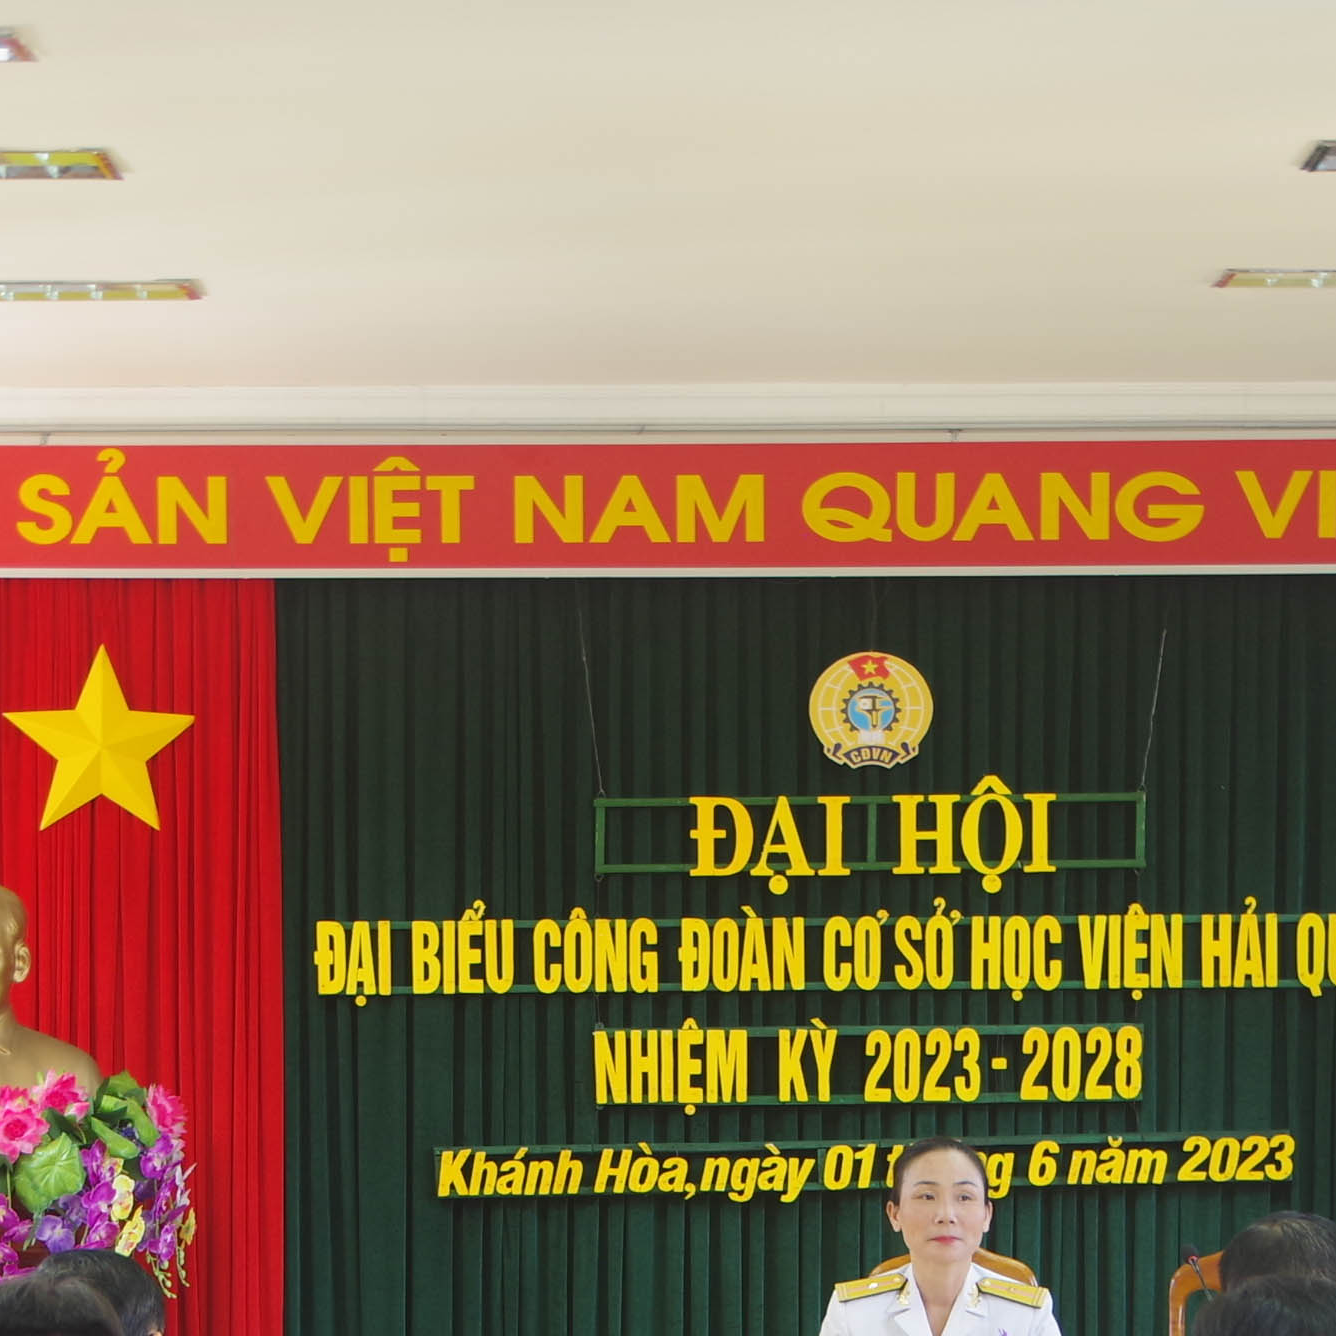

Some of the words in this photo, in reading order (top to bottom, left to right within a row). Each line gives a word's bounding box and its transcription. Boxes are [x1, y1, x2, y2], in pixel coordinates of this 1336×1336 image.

[16, 447, 228, 546] SẢN
[265, 456, 475, 562] VIỆT
[513, 474, 765, 544] NAM
[801, 471, 1206, 543] QUANG
[689, 795, 852, 895] ĐẠI
[892, 774, 1057, 893] HỘI
[313, 919, 392, 1007] ĐẠI
[411, 899, 514, 994] BIỂU
[533, 906, 659, 994] CÔNG
[678, 905, 805, 993] ĐOÀN
[823, 909, 891, 991] CƠ
[894, 897, 965, 991] SỞ
[971, 914, 1063, 1001] HỌC
[1077, 902, 1184, 1001] VIỆN
[1201, 896, 1279, 989] HẢI
[593, 1017, 748, 1116] NHIỆM
[778, 1017, 838, 1103] KỲ
[864, 1028, 981, 1103] 2023
[1020, 1026, 1143, 1102] 2028
[437, 1146, 584, 1197] Khánh
[699, 1143, 816, 1203] ngày
[822, 1143, 877, 1190] 01
[1027, 1139, 1061, 1187] 6
[1066, 1135, 1169, 1186] năm
[1177, 1133, 1297, 1183] 2023
